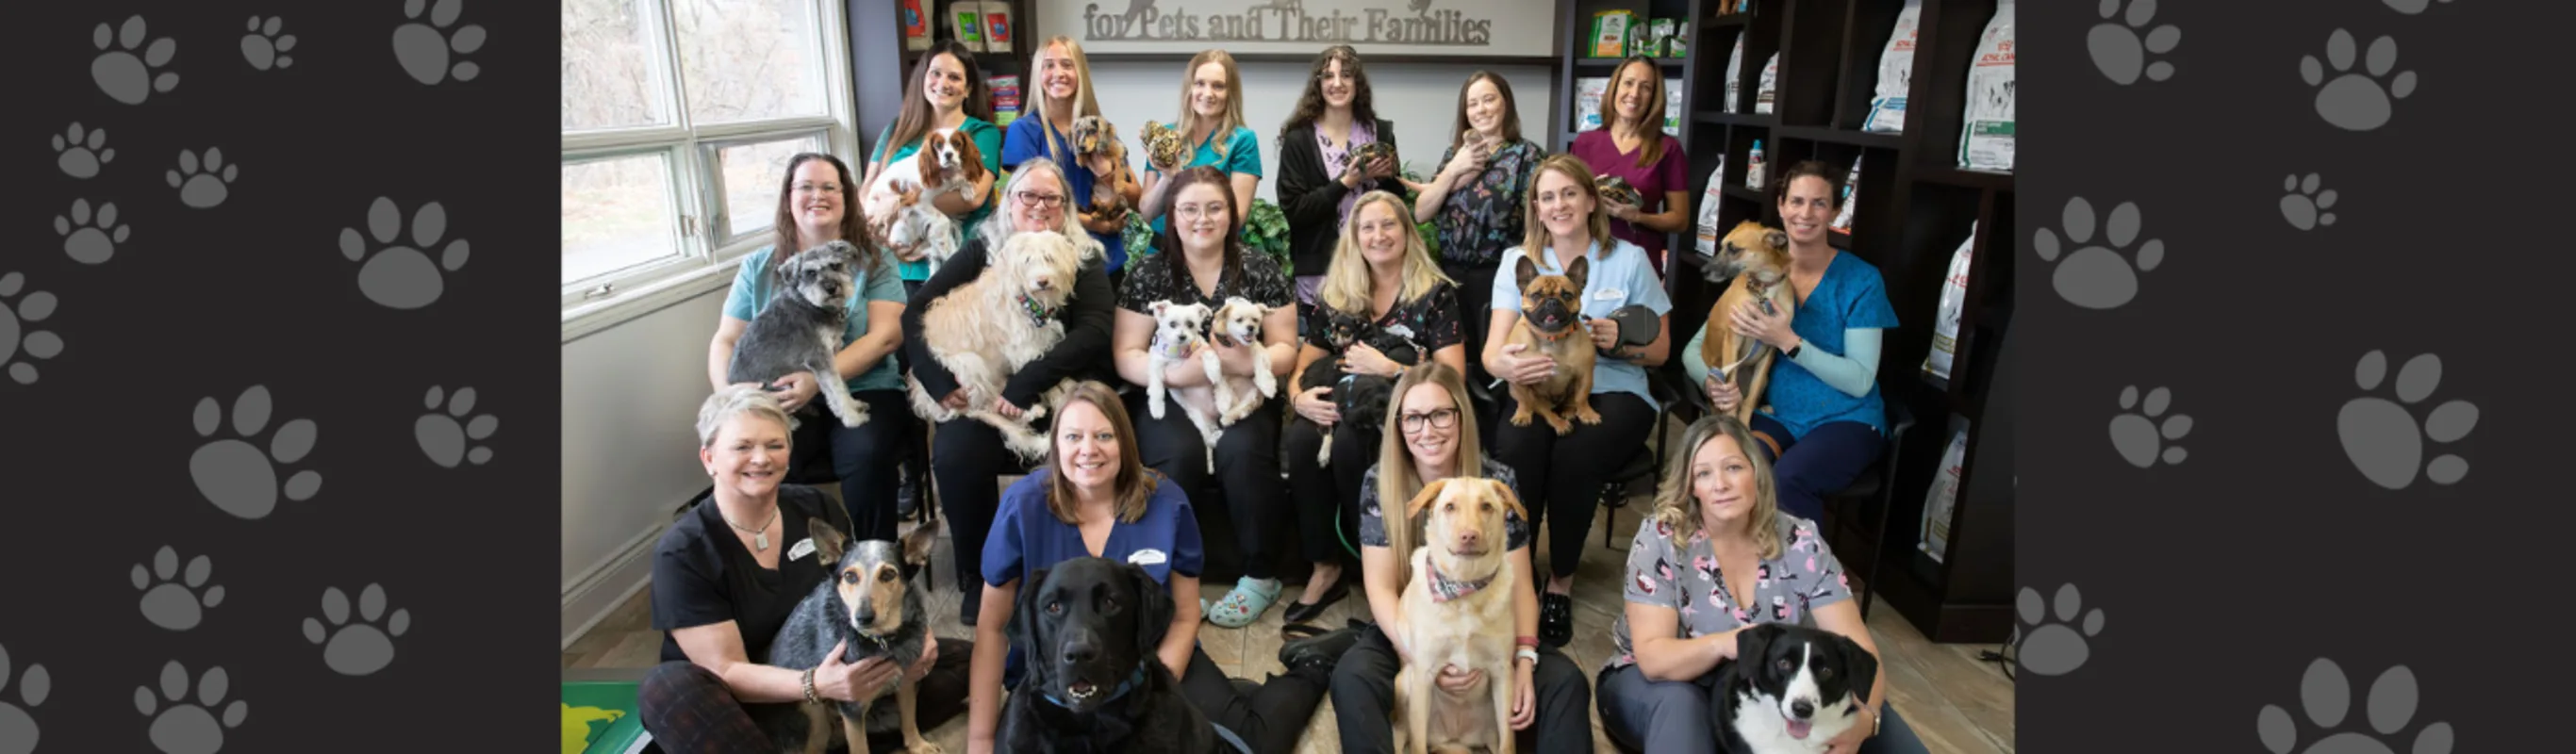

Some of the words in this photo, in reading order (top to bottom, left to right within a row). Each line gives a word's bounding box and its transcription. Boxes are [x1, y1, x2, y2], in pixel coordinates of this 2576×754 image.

[1083, 3, 1128, 40] for
[1136, 5, 1199, 40] Pets
[1208, 6, 1264, 41] and
[1273, 6, 1359, 42] Their
[1363, 8, 1493, 44] Families
